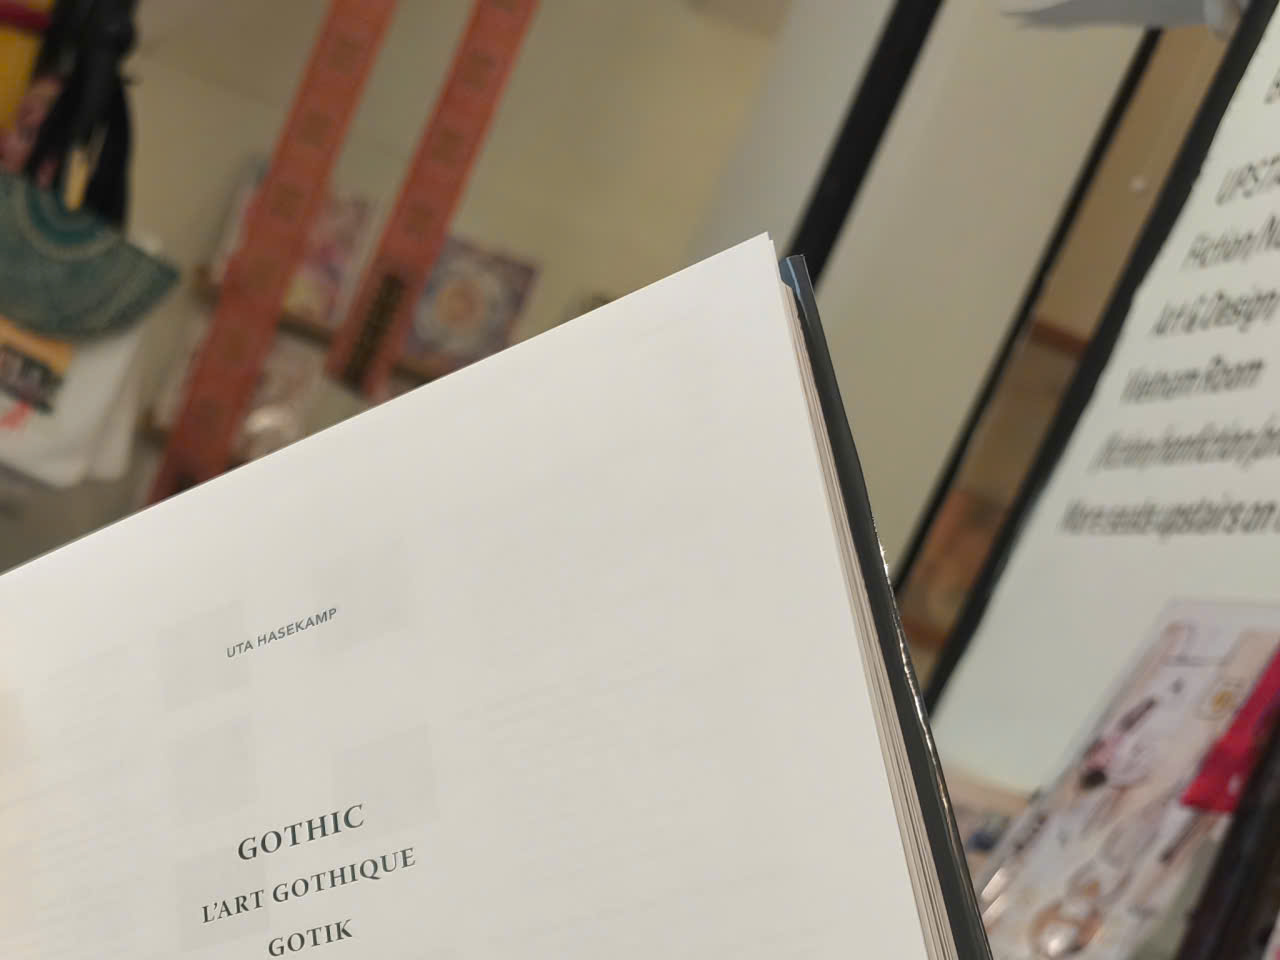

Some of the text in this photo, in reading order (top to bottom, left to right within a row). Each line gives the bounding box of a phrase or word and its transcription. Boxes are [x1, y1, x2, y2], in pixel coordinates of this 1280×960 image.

[226, 607, 337, 658] UTA HASEKAMP
[237, 803, 365, 861] GOTHIC
[201, 847, 417, 924] L’ART GOTHIQUE
[268, 918, 353, 957] GOTIK
